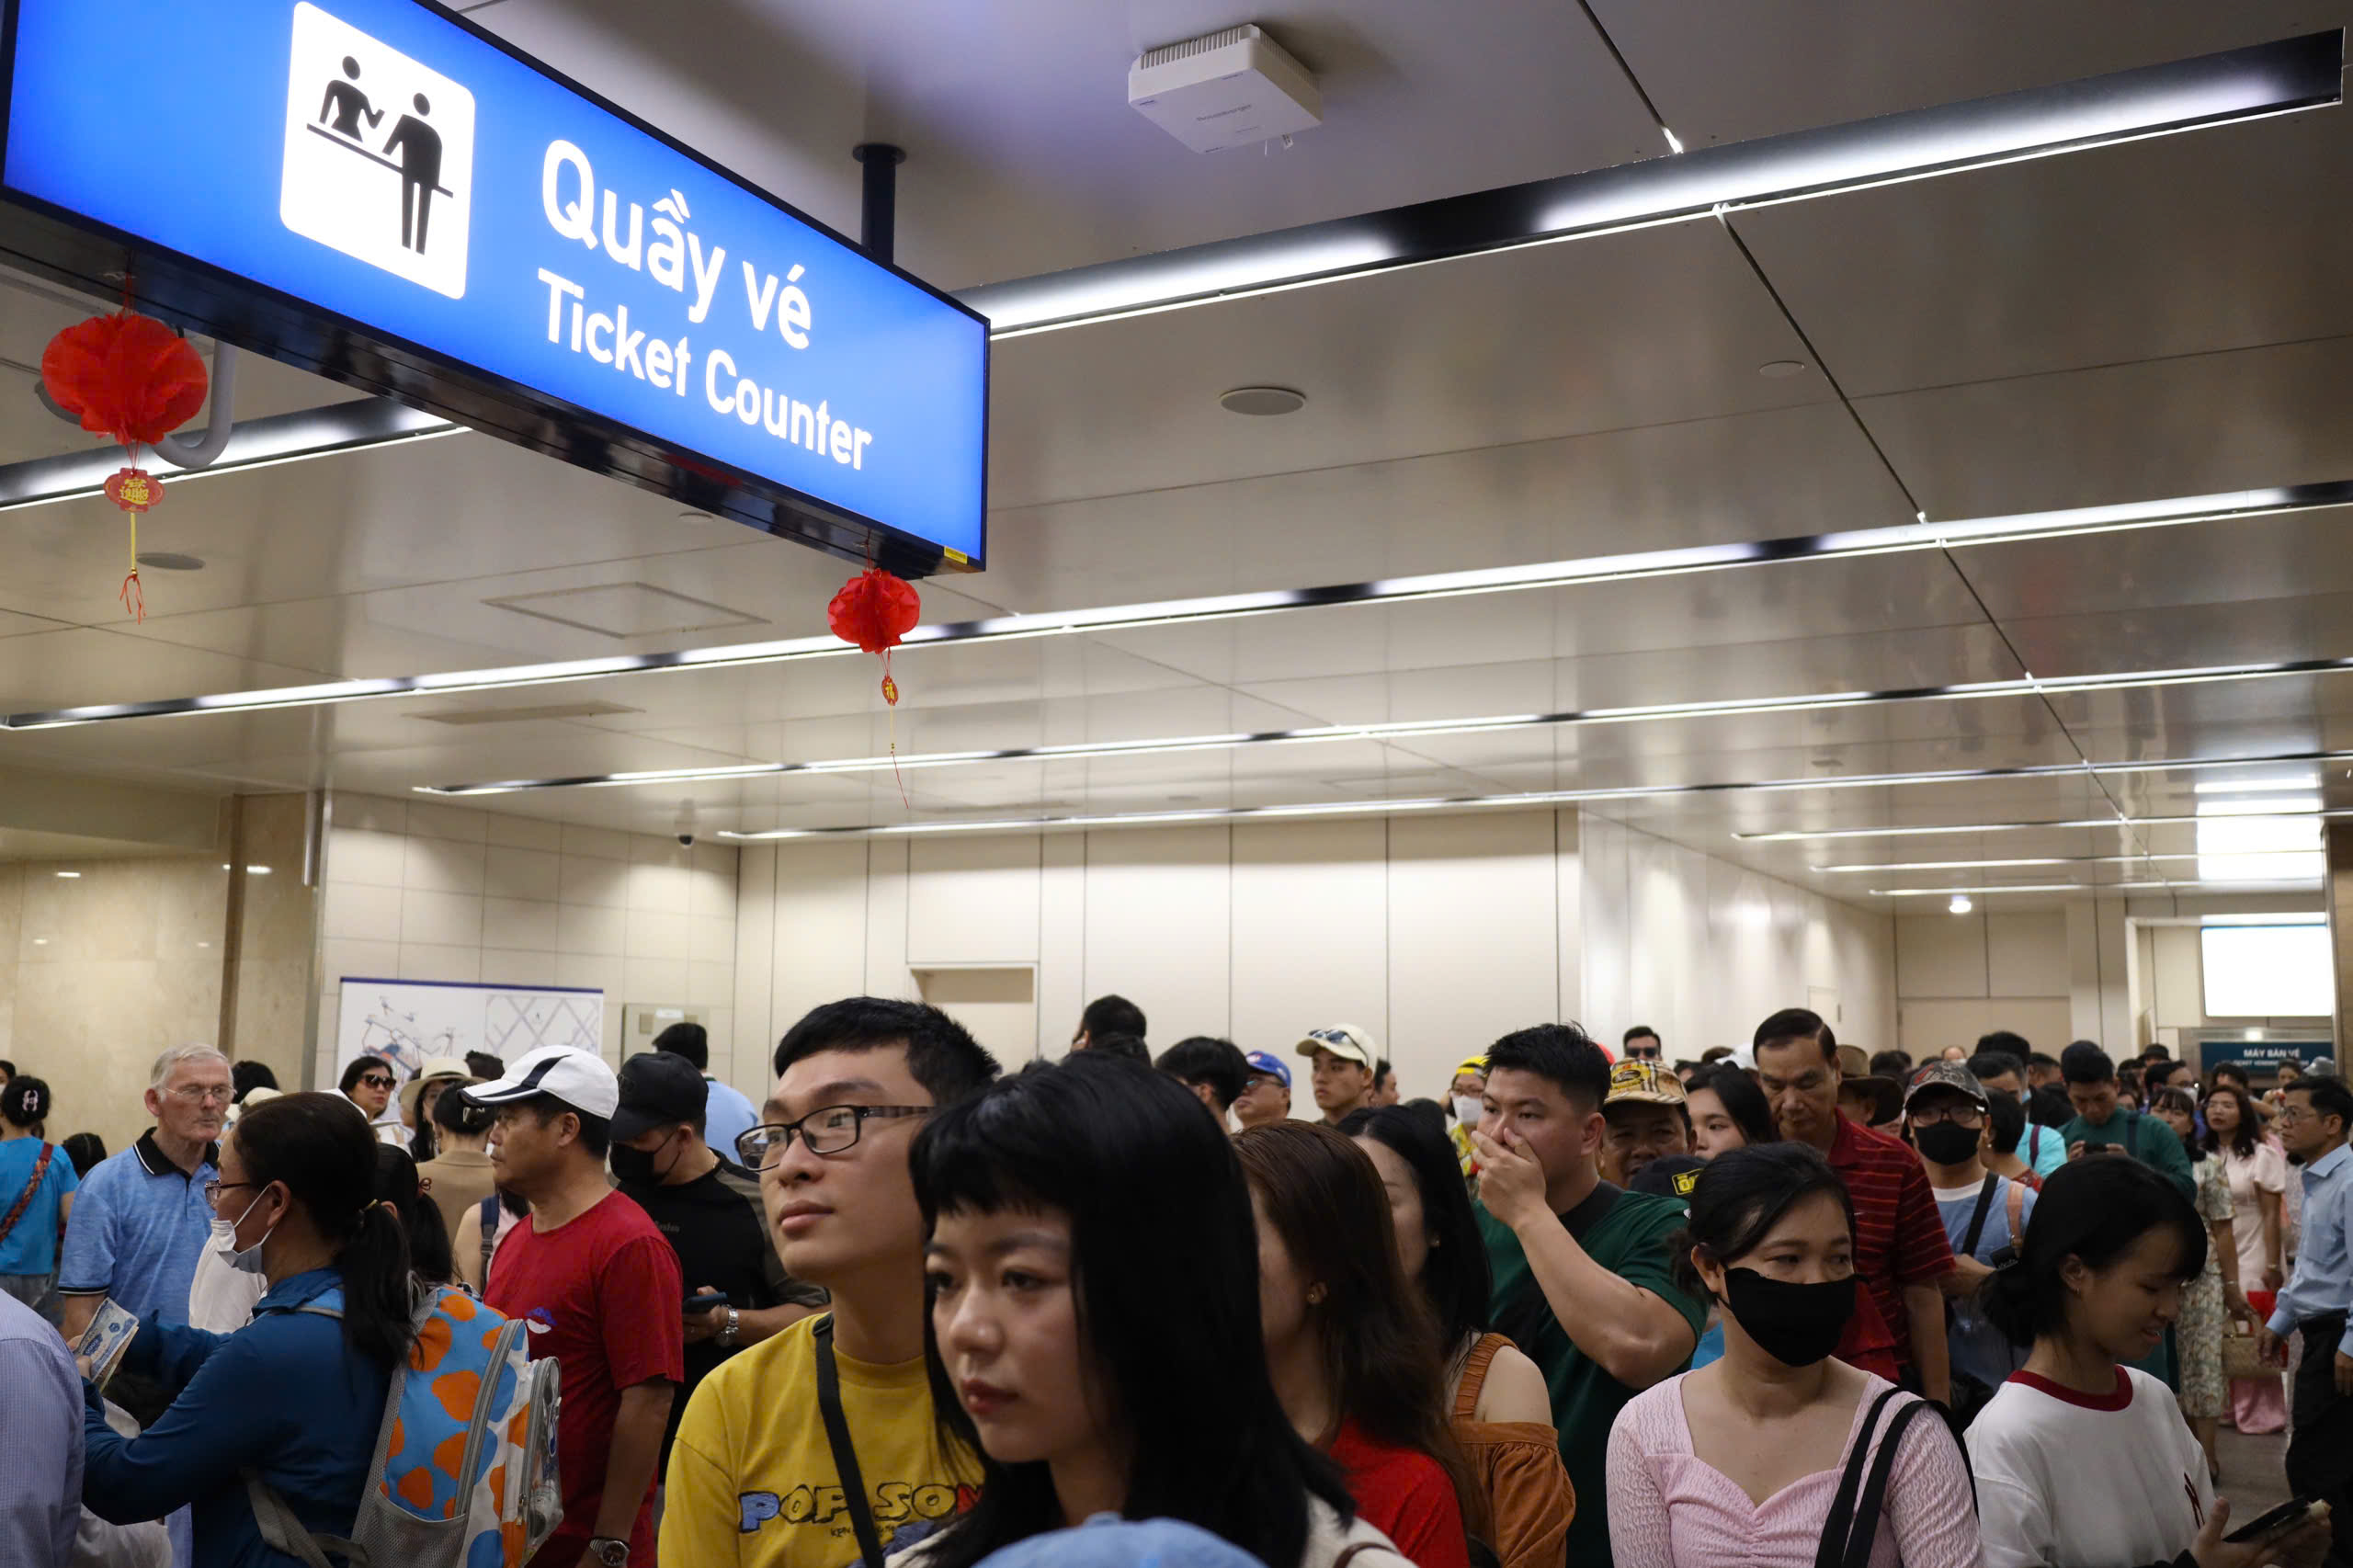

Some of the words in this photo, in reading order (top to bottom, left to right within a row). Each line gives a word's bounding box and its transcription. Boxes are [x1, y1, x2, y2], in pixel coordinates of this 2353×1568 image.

[542, 140, 726, 324] Quầy
[742, 261, 813, 350] vé
[538, 267, 691, 397] Ticket
[705, 349, 873, 471] Counter
